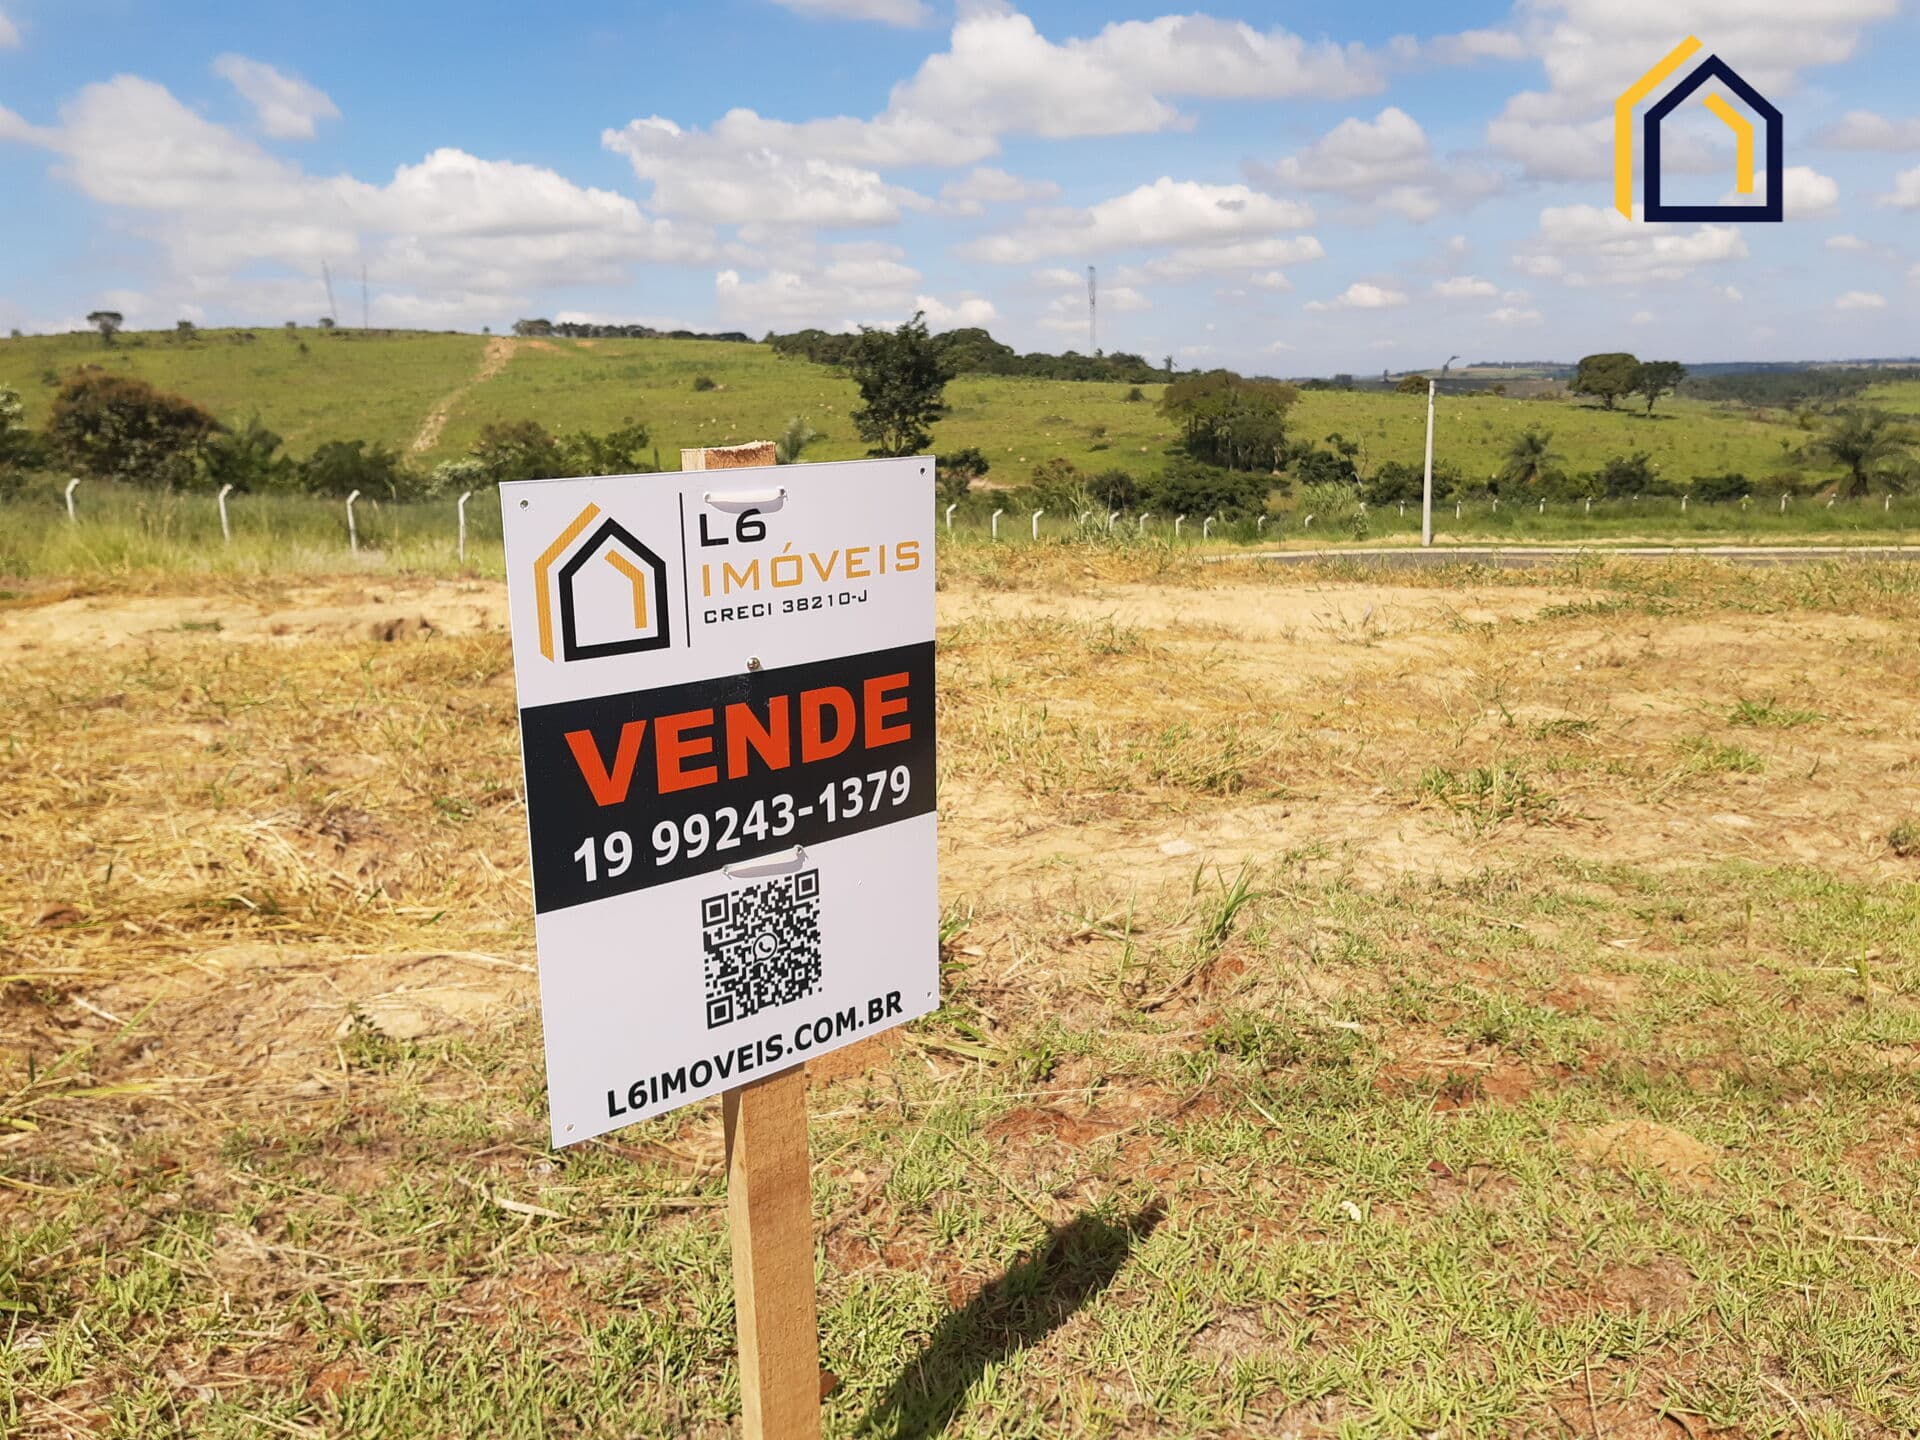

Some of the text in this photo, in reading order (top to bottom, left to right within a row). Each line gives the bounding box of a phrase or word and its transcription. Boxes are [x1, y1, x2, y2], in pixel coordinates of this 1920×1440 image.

[699, 508, 767, 547] L6
[702, 541, 921, 597] IMÓVEIS
[703, 590, 868, 624] CRECI 38210-J
[564, 671, 912, 807] VENDE
[573, 764, 912, 882] 19 99243-1379
[607, 990, 904, 1118] L6IMOVEIS.COM.BR
